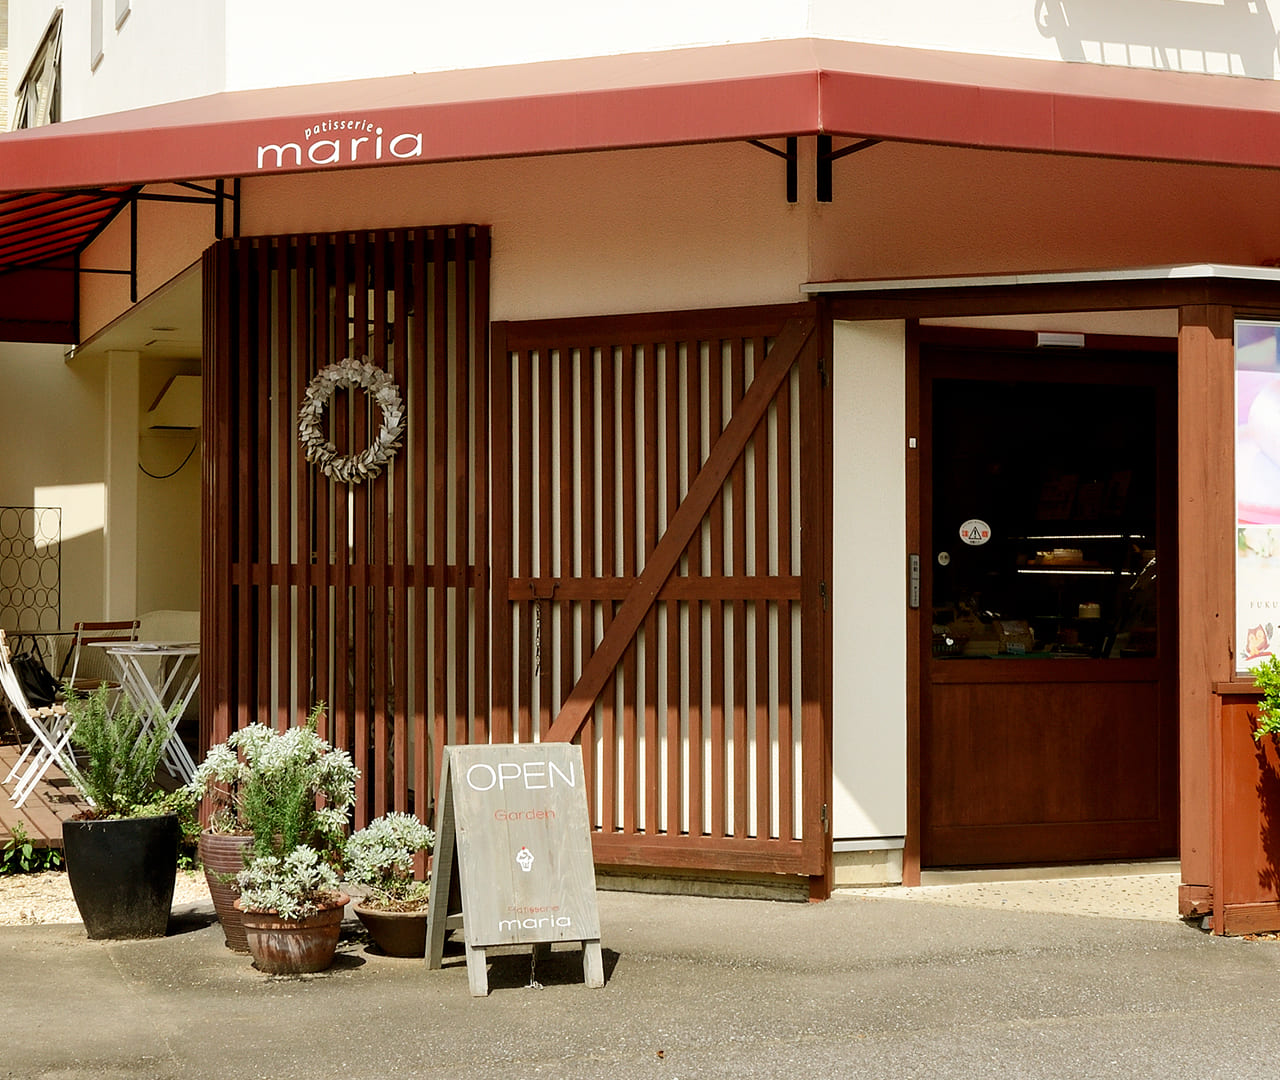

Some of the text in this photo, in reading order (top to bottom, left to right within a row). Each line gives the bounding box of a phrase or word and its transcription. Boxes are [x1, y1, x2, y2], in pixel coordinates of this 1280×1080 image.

[304, 119, 374, 140] patisserie
[257, 127, 423, 169] maria
[466, 761, 575, 791] OPEN
[494, 808, 556, 821] Garden
[498, 914, 571, 932] maria
